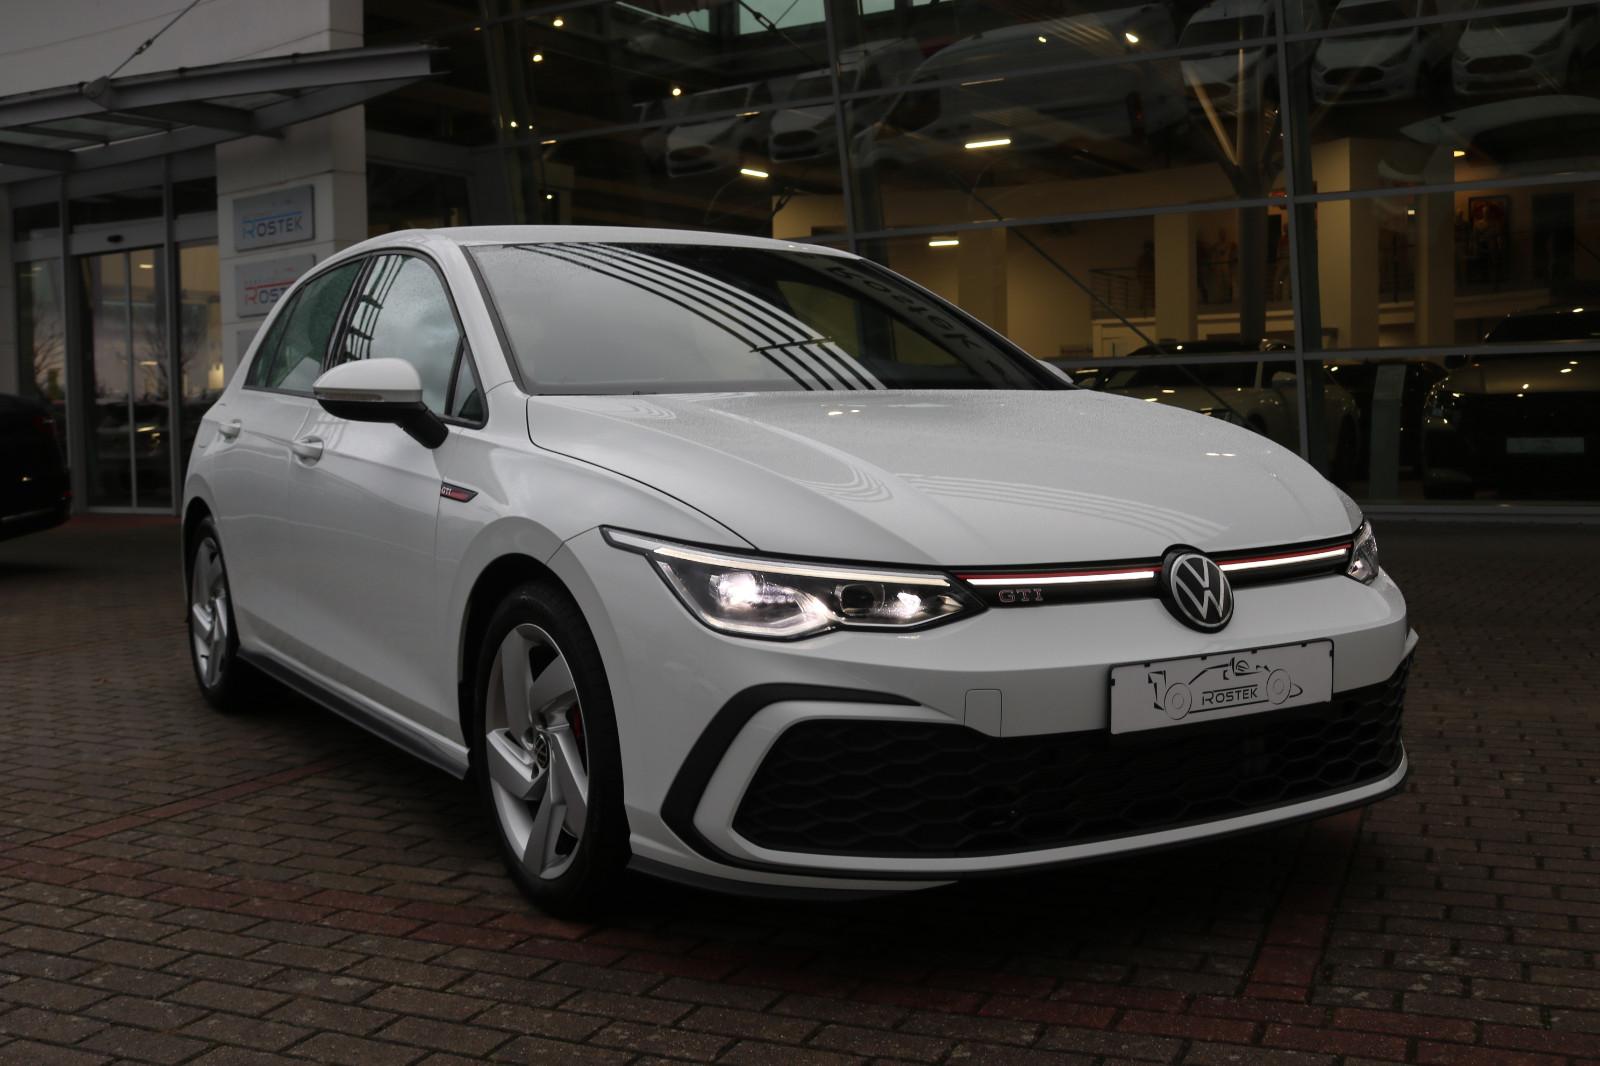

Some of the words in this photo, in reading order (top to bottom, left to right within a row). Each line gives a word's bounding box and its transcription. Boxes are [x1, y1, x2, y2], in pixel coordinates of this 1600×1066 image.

[241, 215, 304, 240] ROSTEK
[997, 588, 1044, 604] GTI
[1202, 687, 1258, 705] ROSTEK
